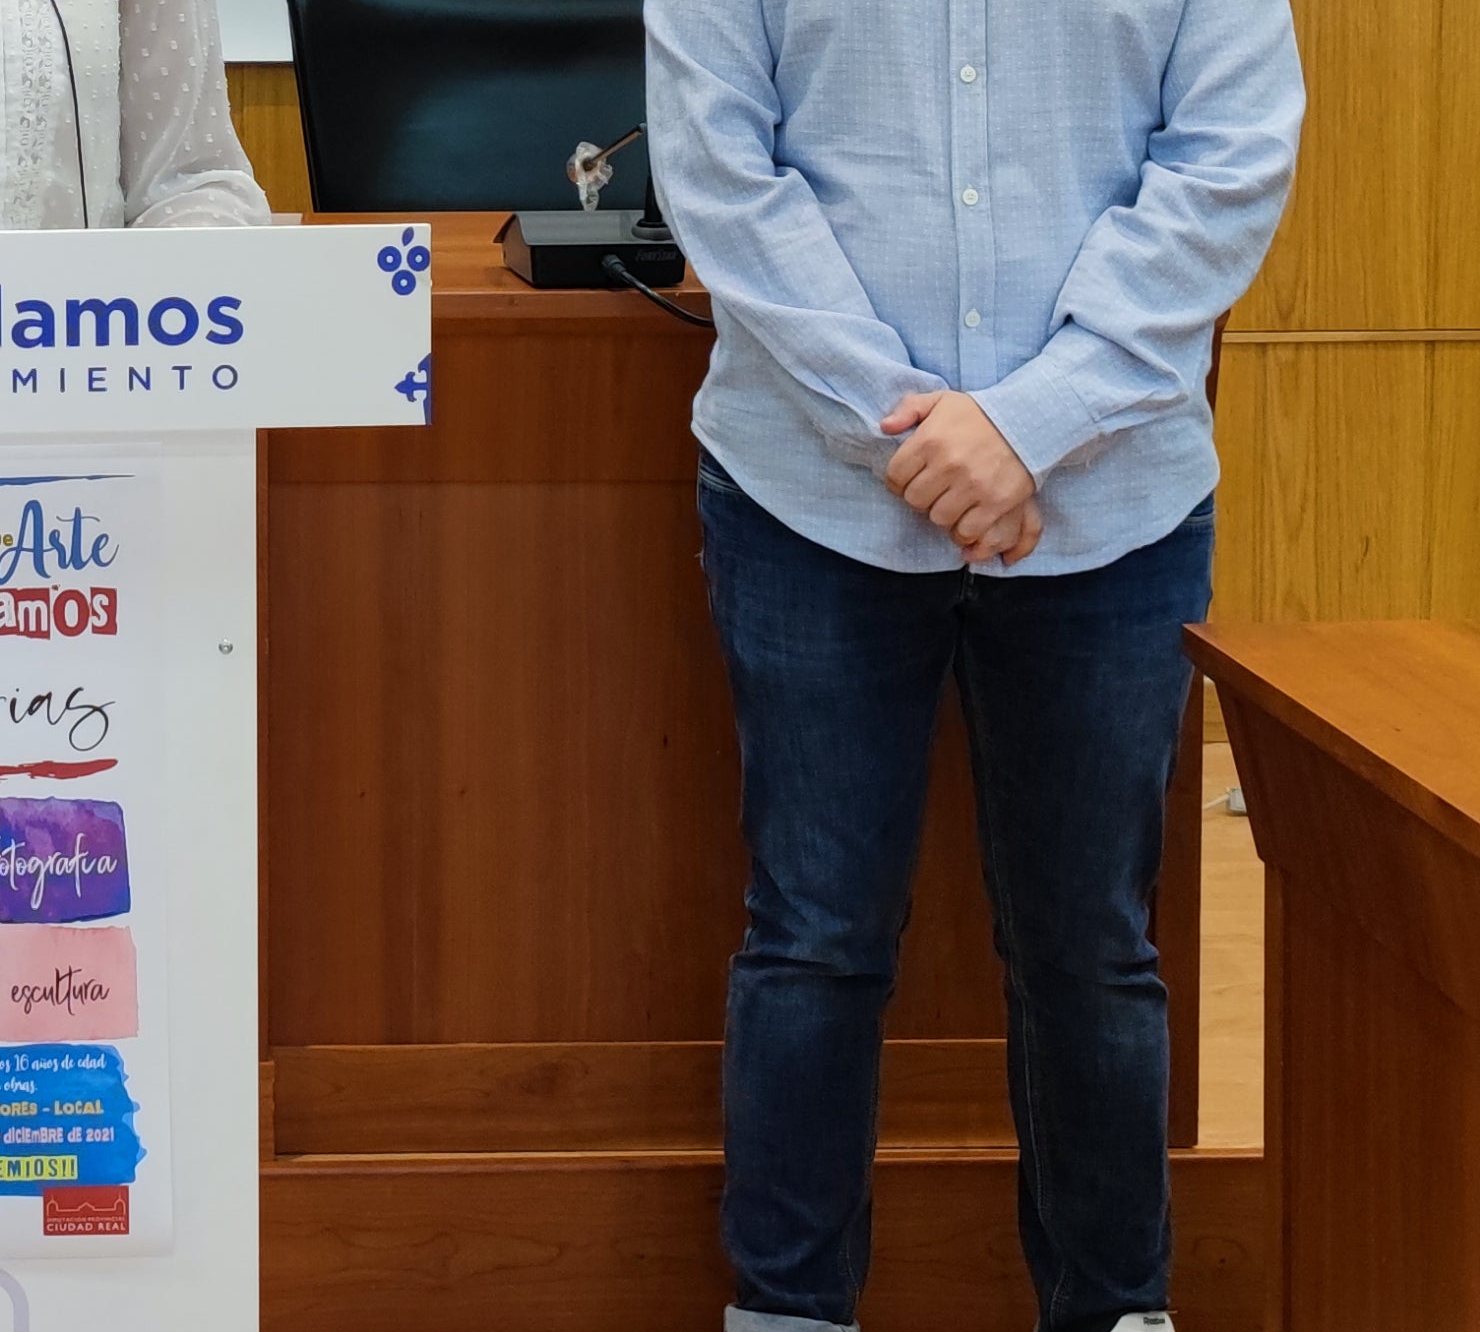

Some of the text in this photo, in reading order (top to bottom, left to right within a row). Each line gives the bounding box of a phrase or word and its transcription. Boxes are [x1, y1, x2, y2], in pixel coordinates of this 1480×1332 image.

[11, 965, 110, 1017] escultura
[13, 1053, 30, 1072] 16
[31, 1057, 59, 1073] años
[60, 1053, 75, 1071] de
[77, 1053, 107, 1070] edad
[85, 1126, 115, 1143] 2021
[46, 1221, 127, 1232] CIUDAD REAL
